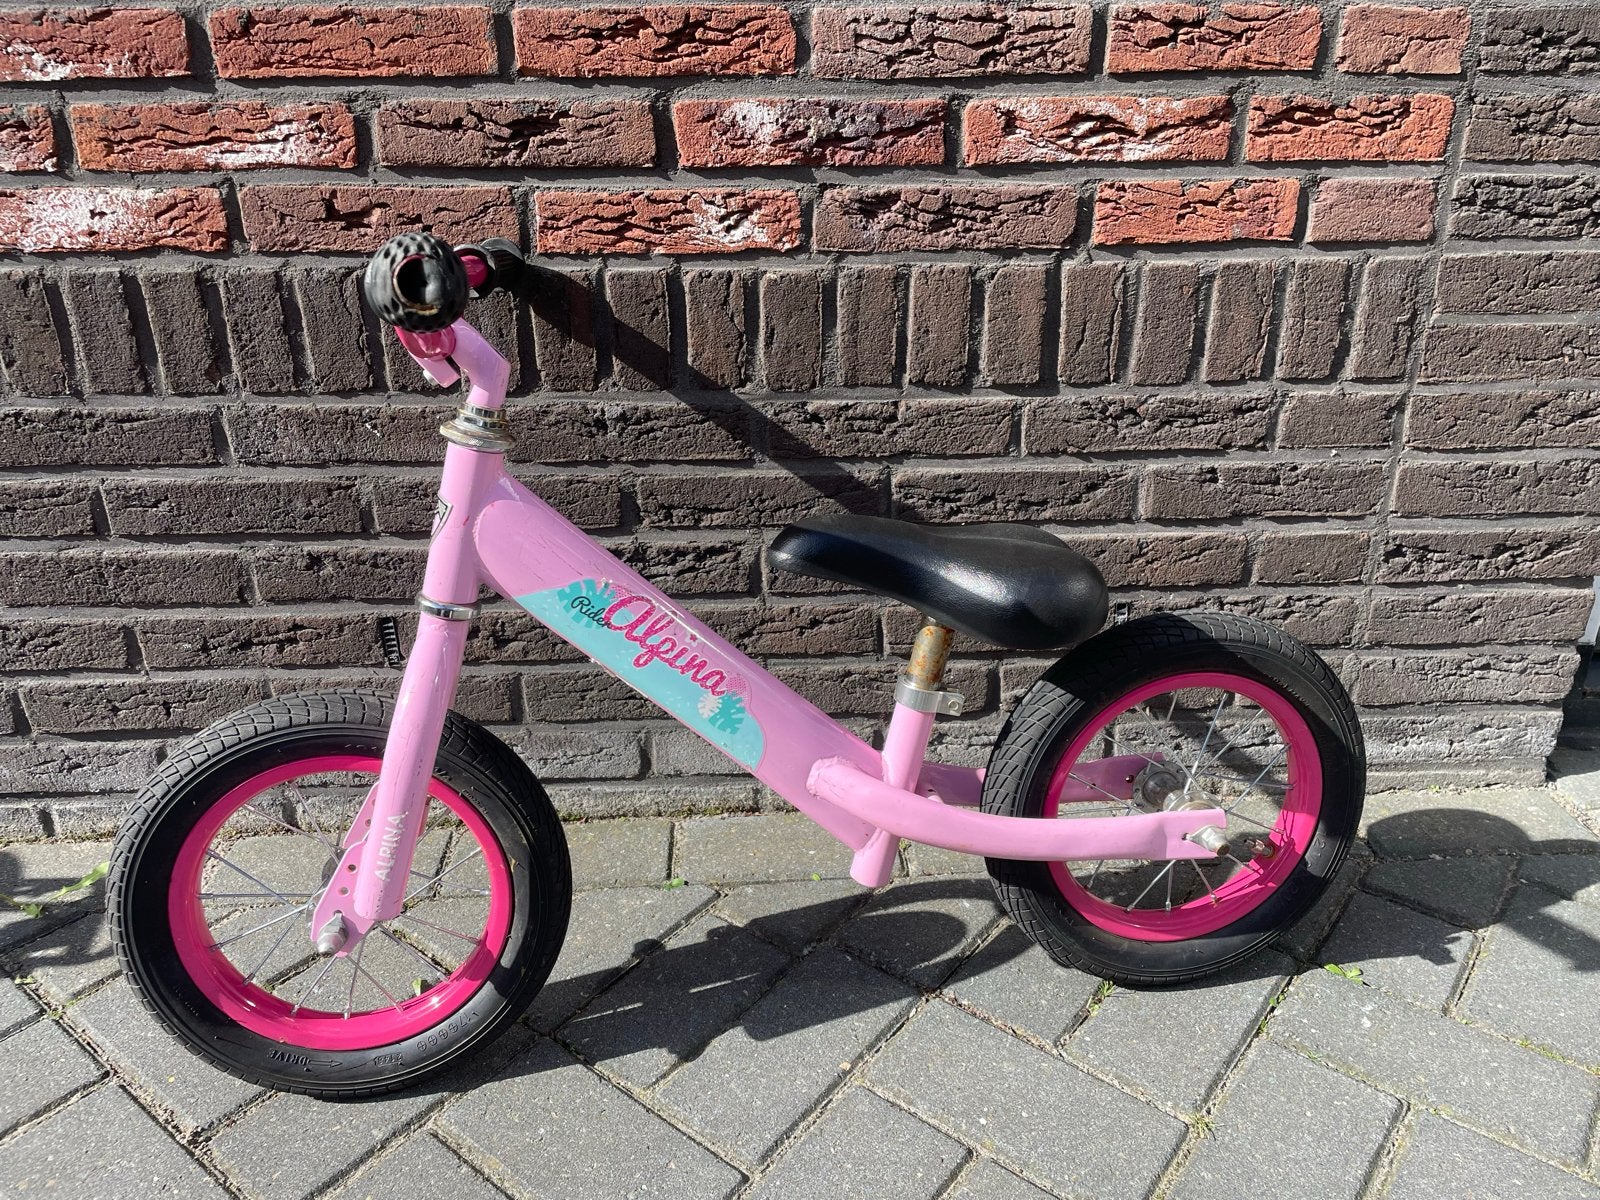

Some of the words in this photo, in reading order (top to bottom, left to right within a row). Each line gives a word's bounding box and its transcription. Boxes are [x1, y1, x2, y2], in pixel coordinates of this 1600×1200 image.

[602, 595, 728, 697] Alpina
[374, 814, 405, 881] ALPINA
[268, 1048, 307, 1066] DRIVE
